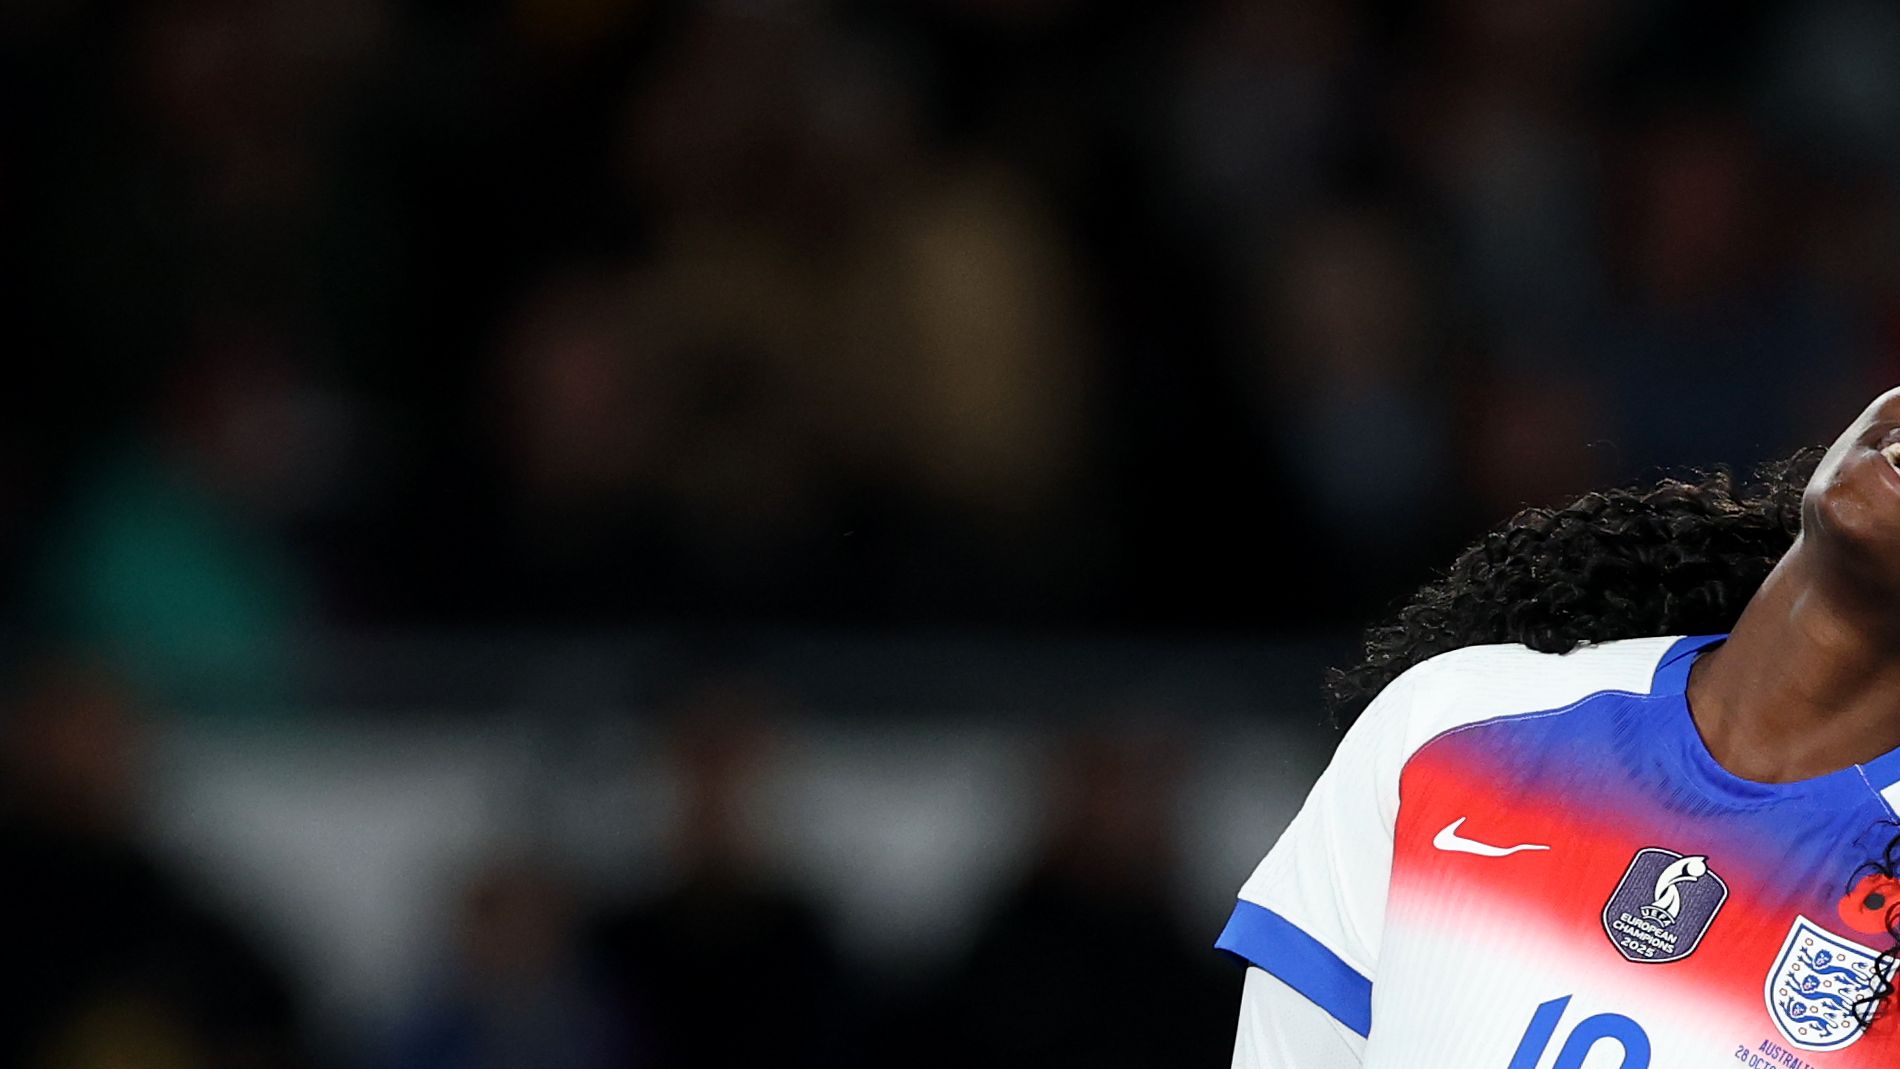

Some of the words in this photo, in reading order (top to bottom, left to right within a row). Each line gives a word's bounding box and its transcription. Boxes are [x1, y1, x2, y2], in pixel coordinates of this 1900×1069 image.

[1620, 913, 1677, 943] EUROPEAN
[1641, 909, 1672, 927] UEFA
[1612, 921, 1674, 954] CHAMPIONS
[1620, 937, 1656, 958] 2025
[1735, 1045, 1750, 1062] 28
